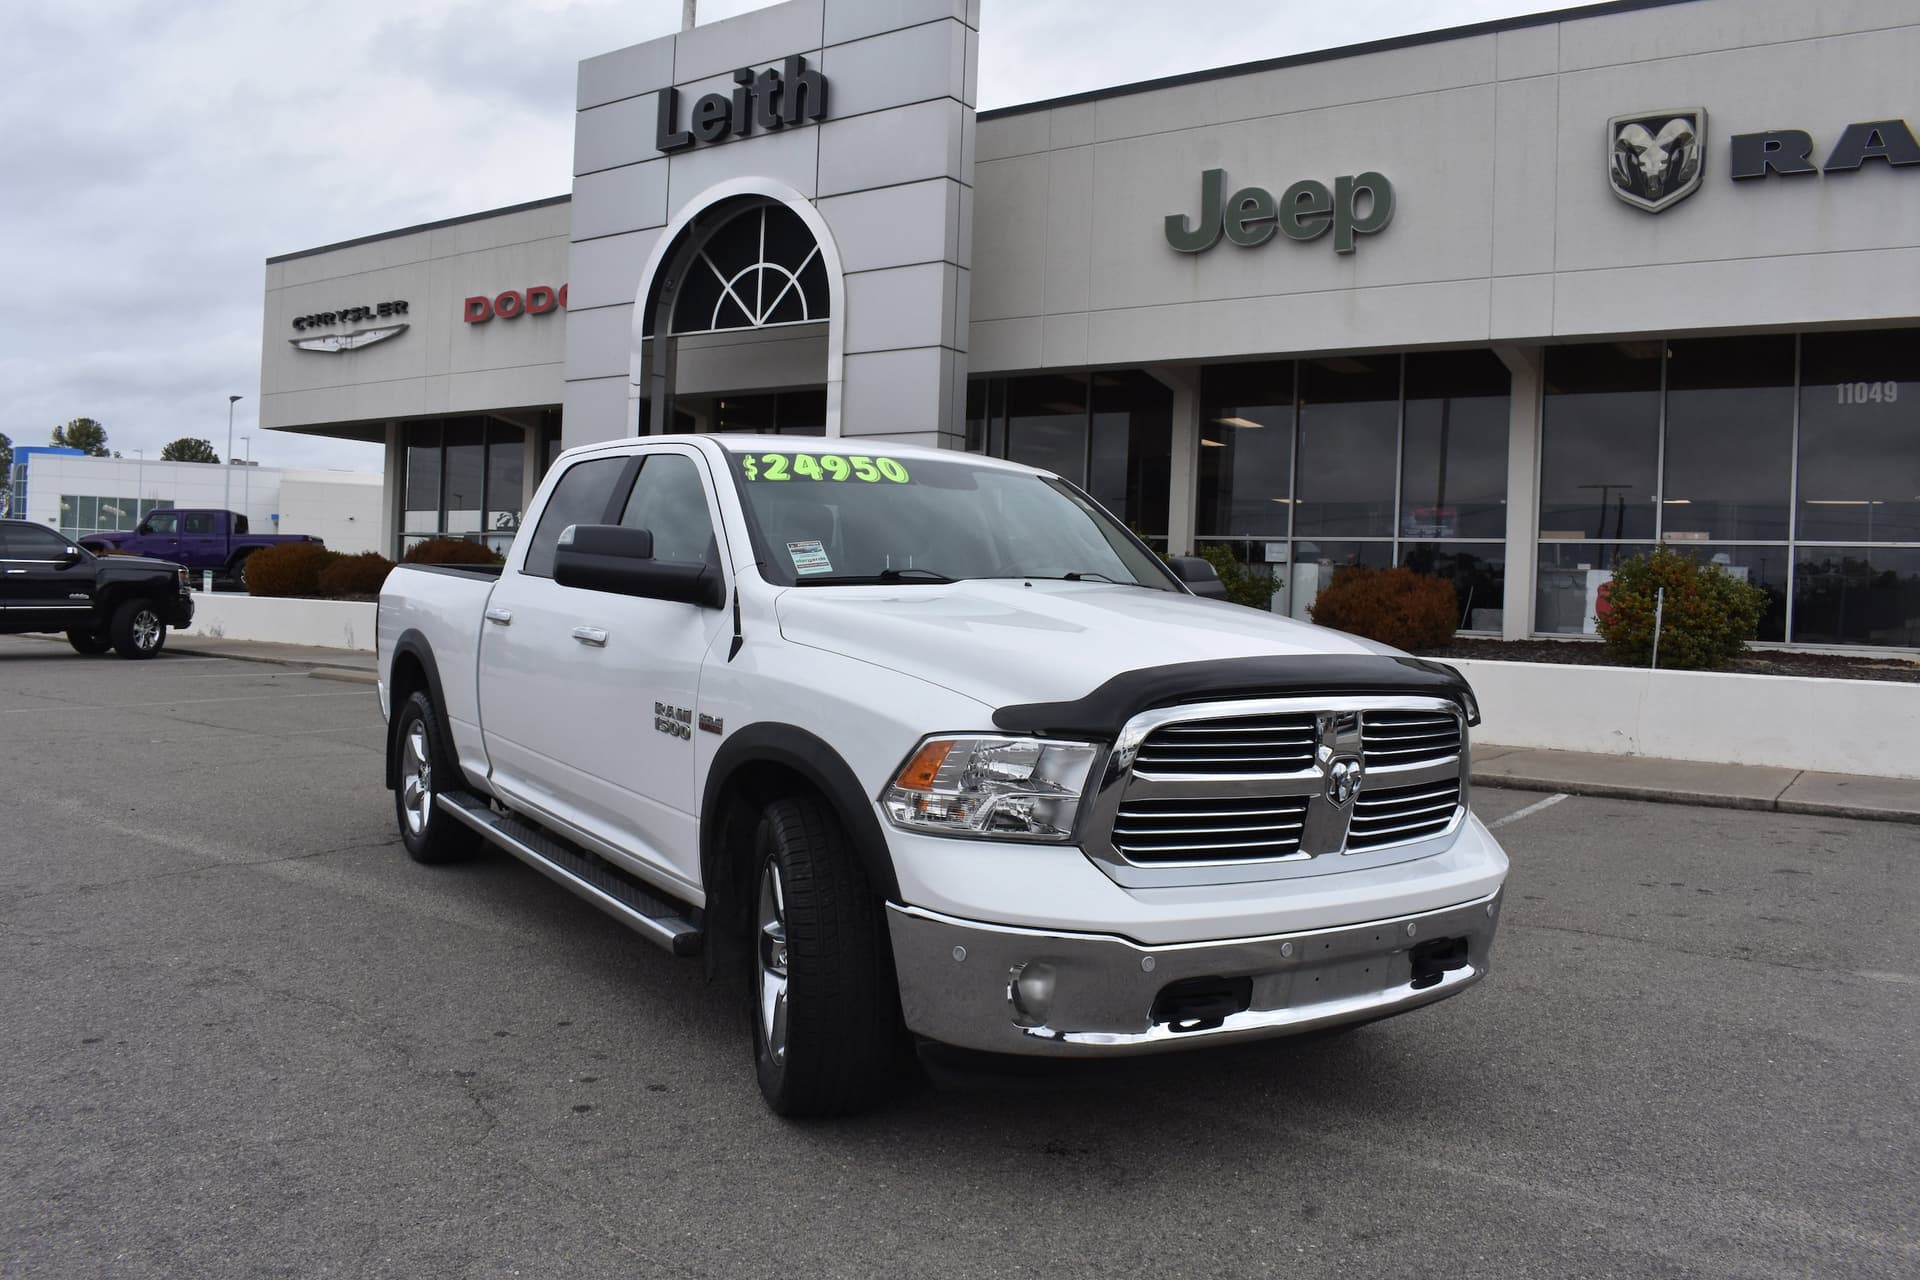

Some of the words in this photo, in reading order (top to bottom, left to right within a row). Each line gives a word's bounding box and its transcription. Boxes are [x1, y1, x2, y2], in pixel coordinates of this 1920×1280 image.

[657, 54, 828, 152] Leith
[1165, 168, 1396, 254] Jeep
[292, 300, 409, 330] CHRYSLER
[464, 284, 568, 324] DOD
[1836, 381, 1898, 404] 11049
[743, 454, 909, 483] $24950
[654, 700, 692, 724] RAM
[654, 715, 692, 740] 1500
